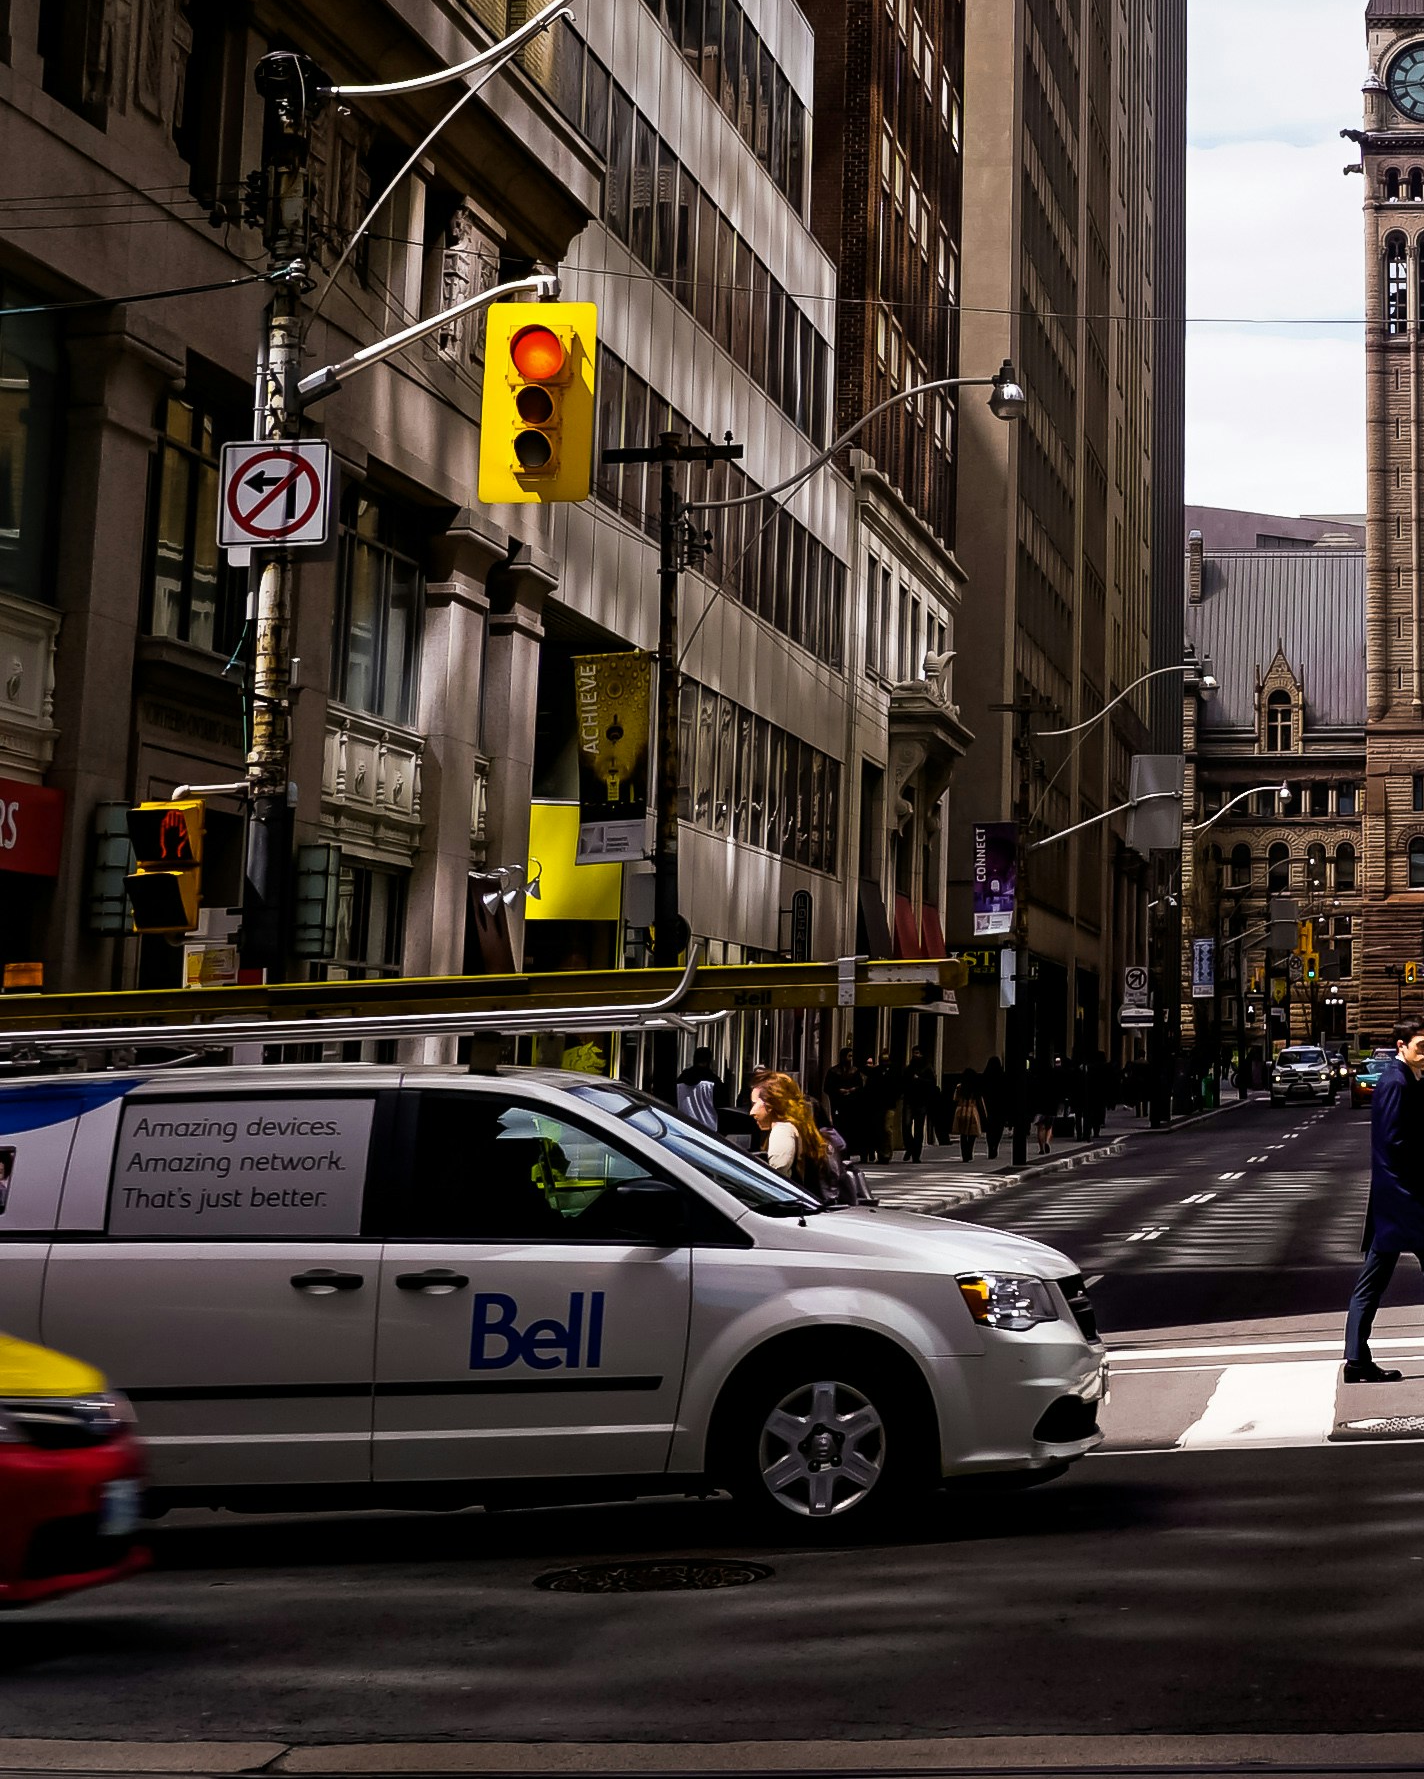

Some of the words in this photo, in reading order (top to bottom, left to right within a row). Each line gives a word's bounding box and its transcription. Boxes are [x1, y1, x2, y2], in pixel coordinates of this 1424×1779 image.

[579, 663, 601, 756] ACHIEVE
[975, 827, 987, 883] CONNECT
[733, 989, 772, 1006] Bell
[132, 1117, 239, 1144] Amazing
[245, 1116, 342, 1137] devices.
[125, 1151, 233, 1179] Amazing
[239, 1150, 347, 1171] network.
[121, 1186, 193, 1209] That's
[194, 1185, 244, 1215] just
[249, 1186, 328, 1209] better.
[468, 1290, 606, 1371] Bell
